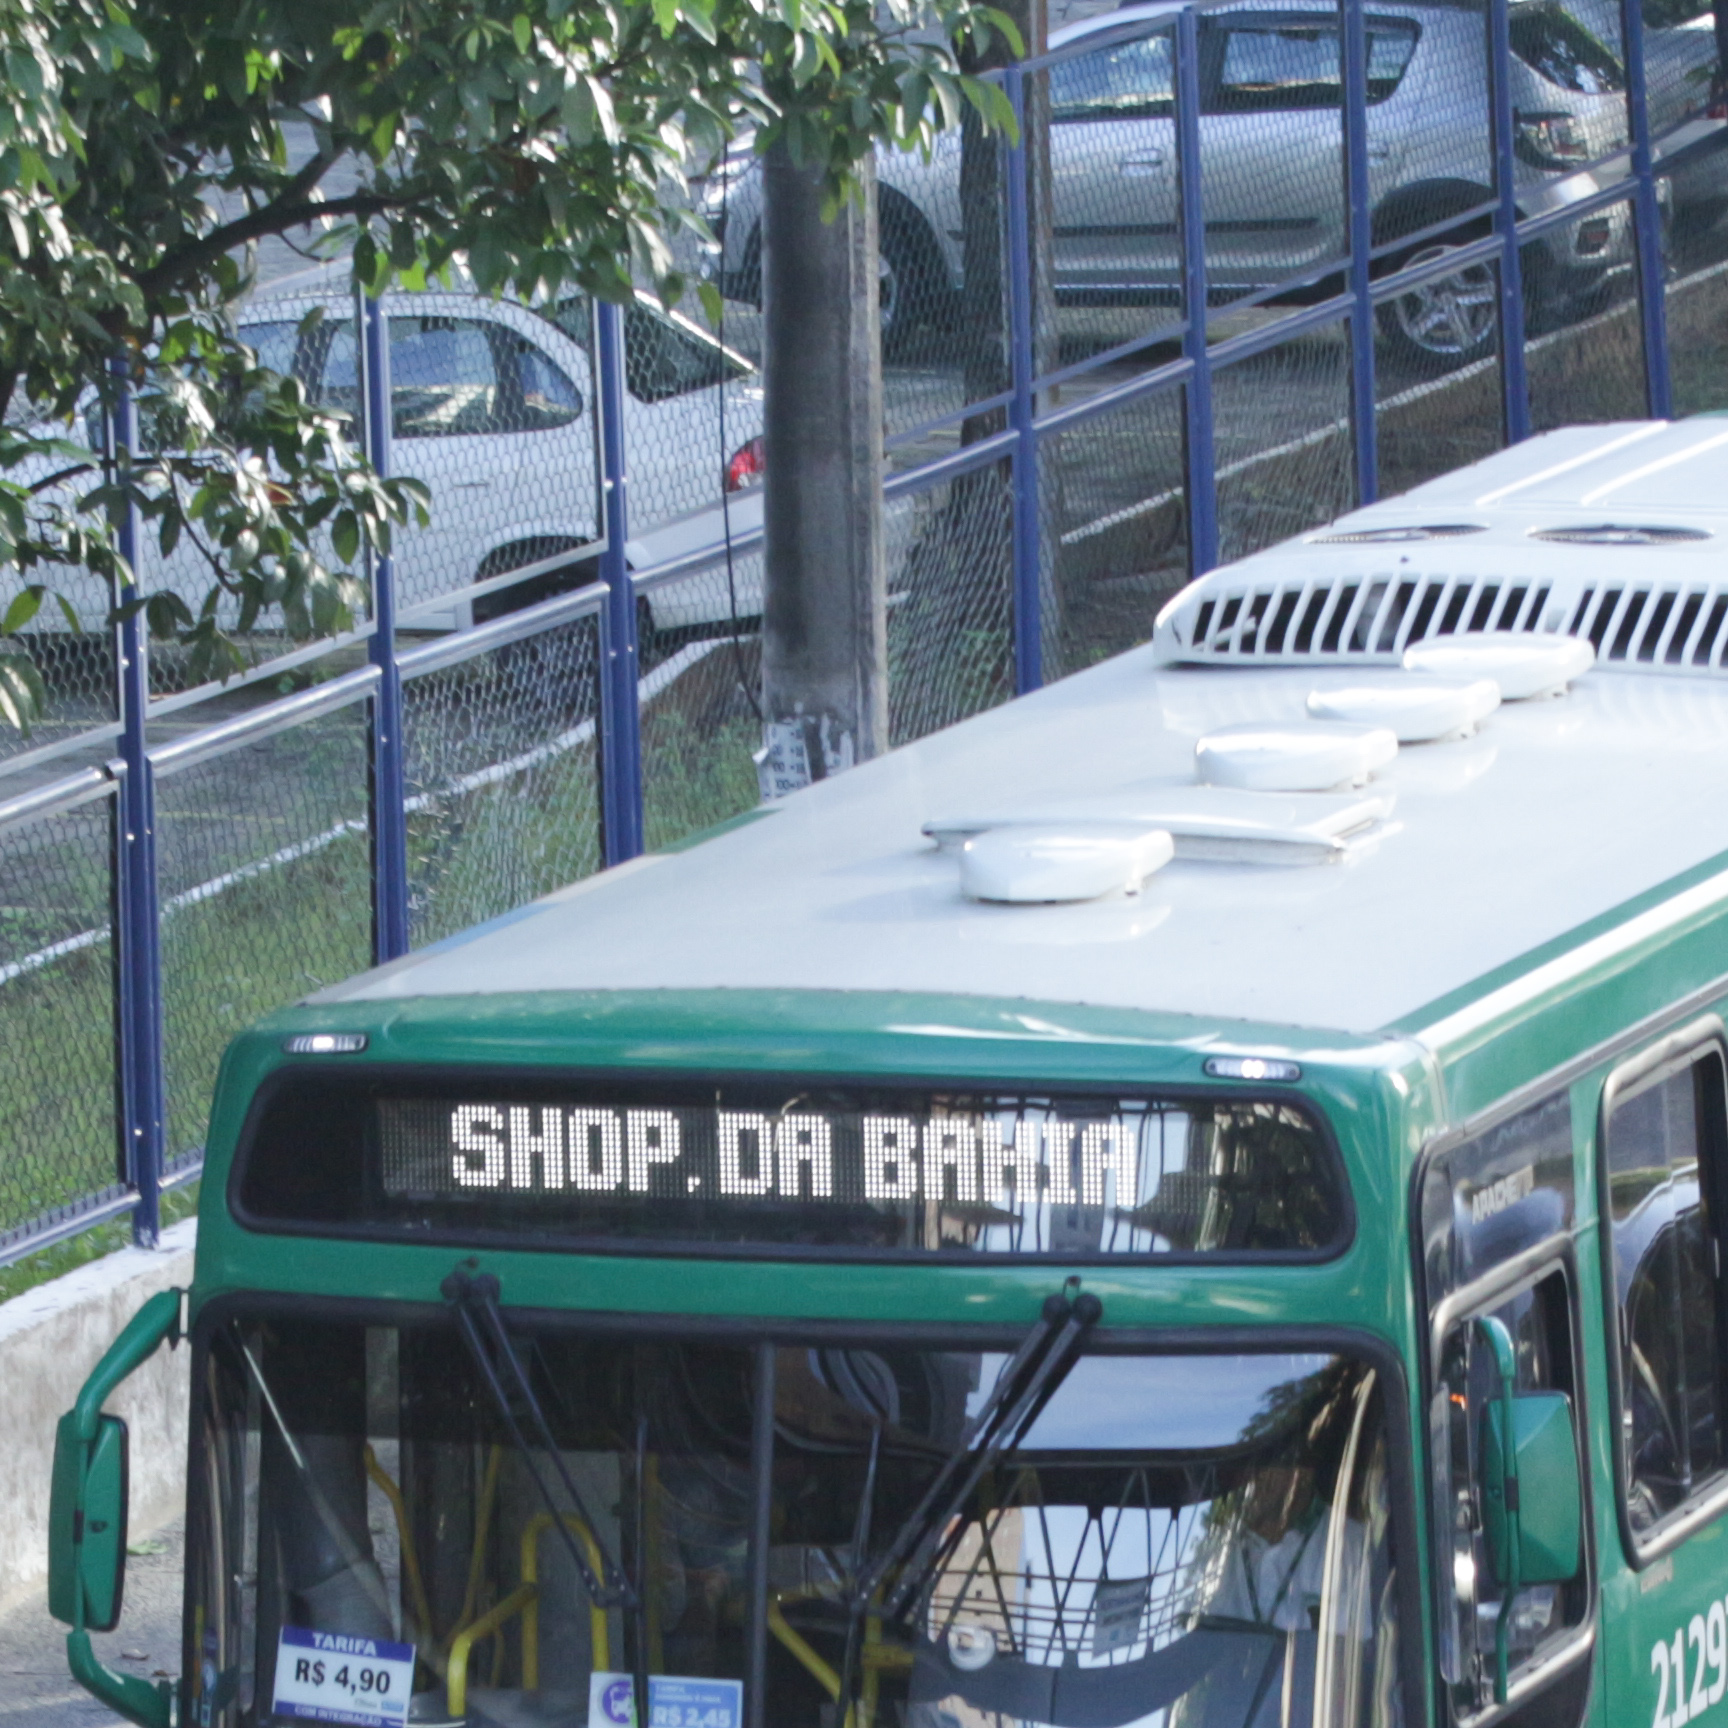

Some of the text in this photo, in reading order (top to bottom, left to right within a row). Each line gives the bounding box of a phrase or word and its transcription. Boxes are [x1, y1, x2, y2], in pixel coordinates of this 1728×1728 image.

[862, 1116, 1136, 1206] BAHIA
[312, 1632, 377, 1657] TARIFA
[295, 1658, 391, 1697] R$ 4,90
